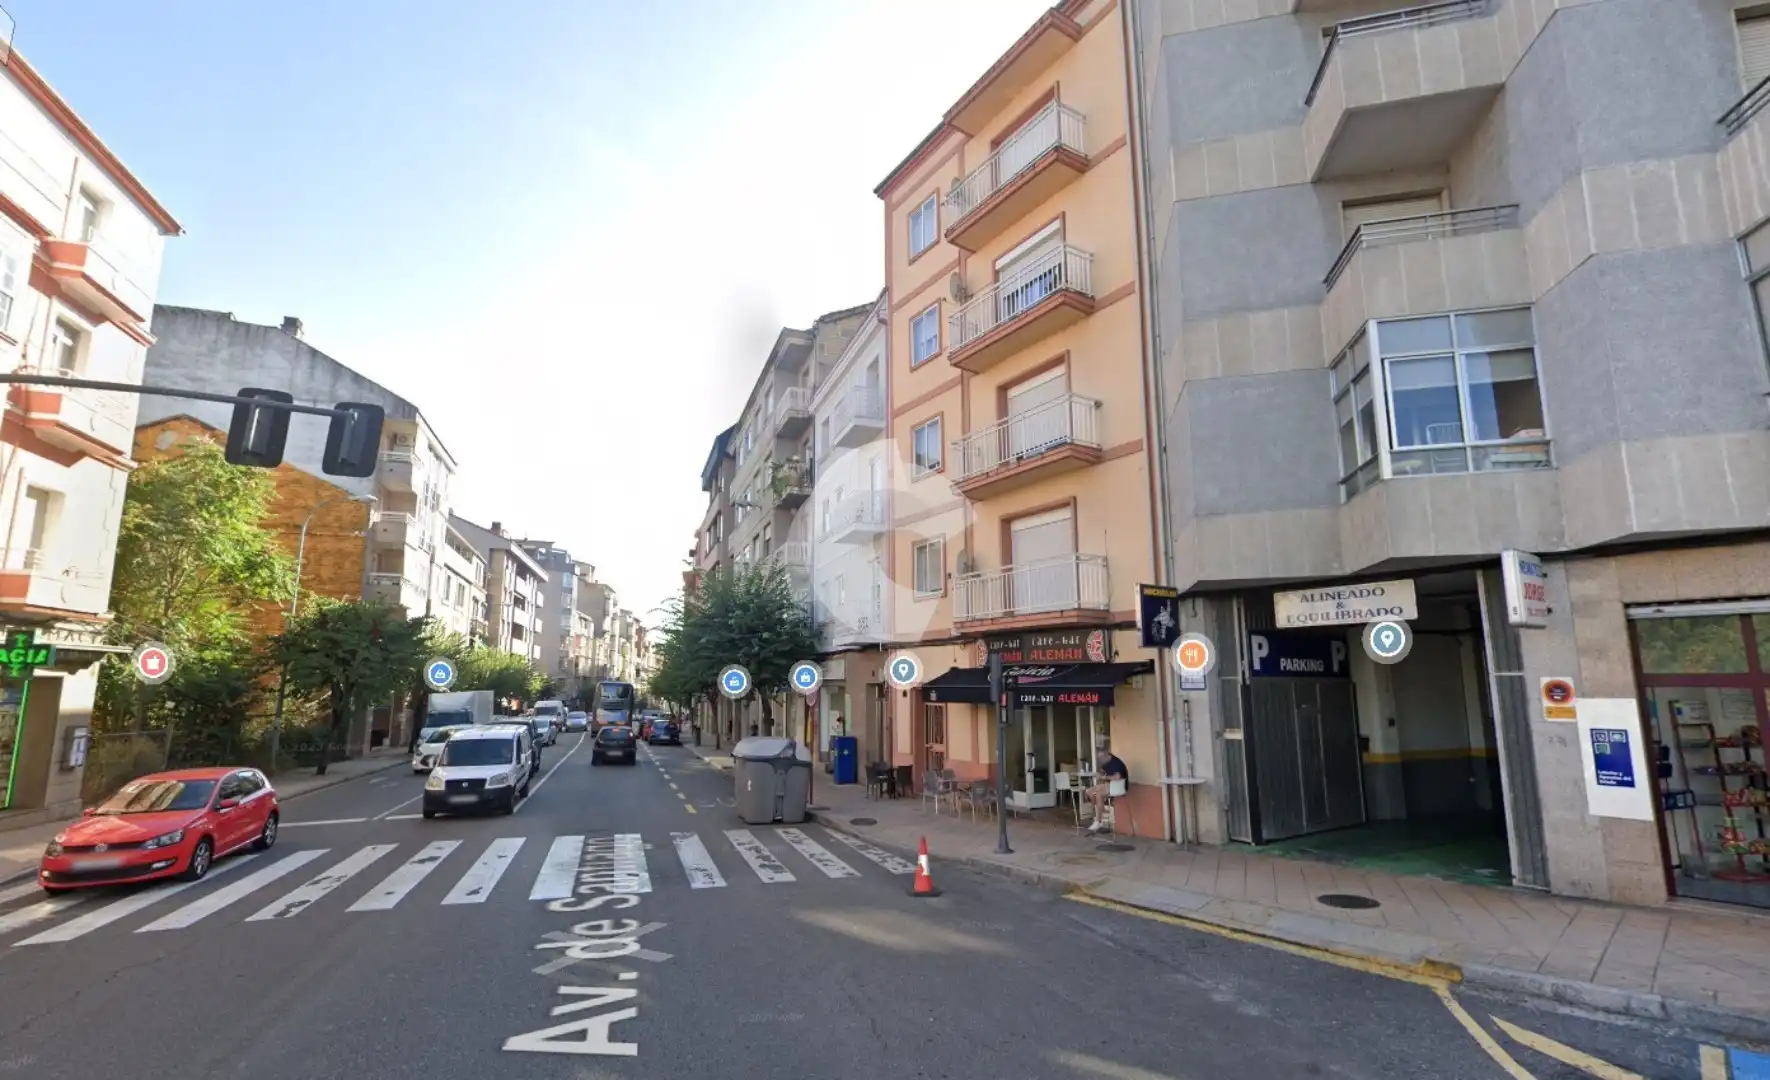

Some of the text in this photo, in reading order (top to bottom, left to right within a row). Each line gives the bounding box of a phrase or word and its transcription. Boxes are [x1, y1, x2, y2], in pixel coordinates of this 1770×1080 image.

[1300, 587, 1386, 604] ALINEADO
[1336, 602, 1345, 610] &
[1287, 606, 1404, 624] EQUILIBRADO
[1250, 634, 1270, 670] P
[1331, 640, 1347, 673] P
[1280, 657, 1325, 672] PARKING
